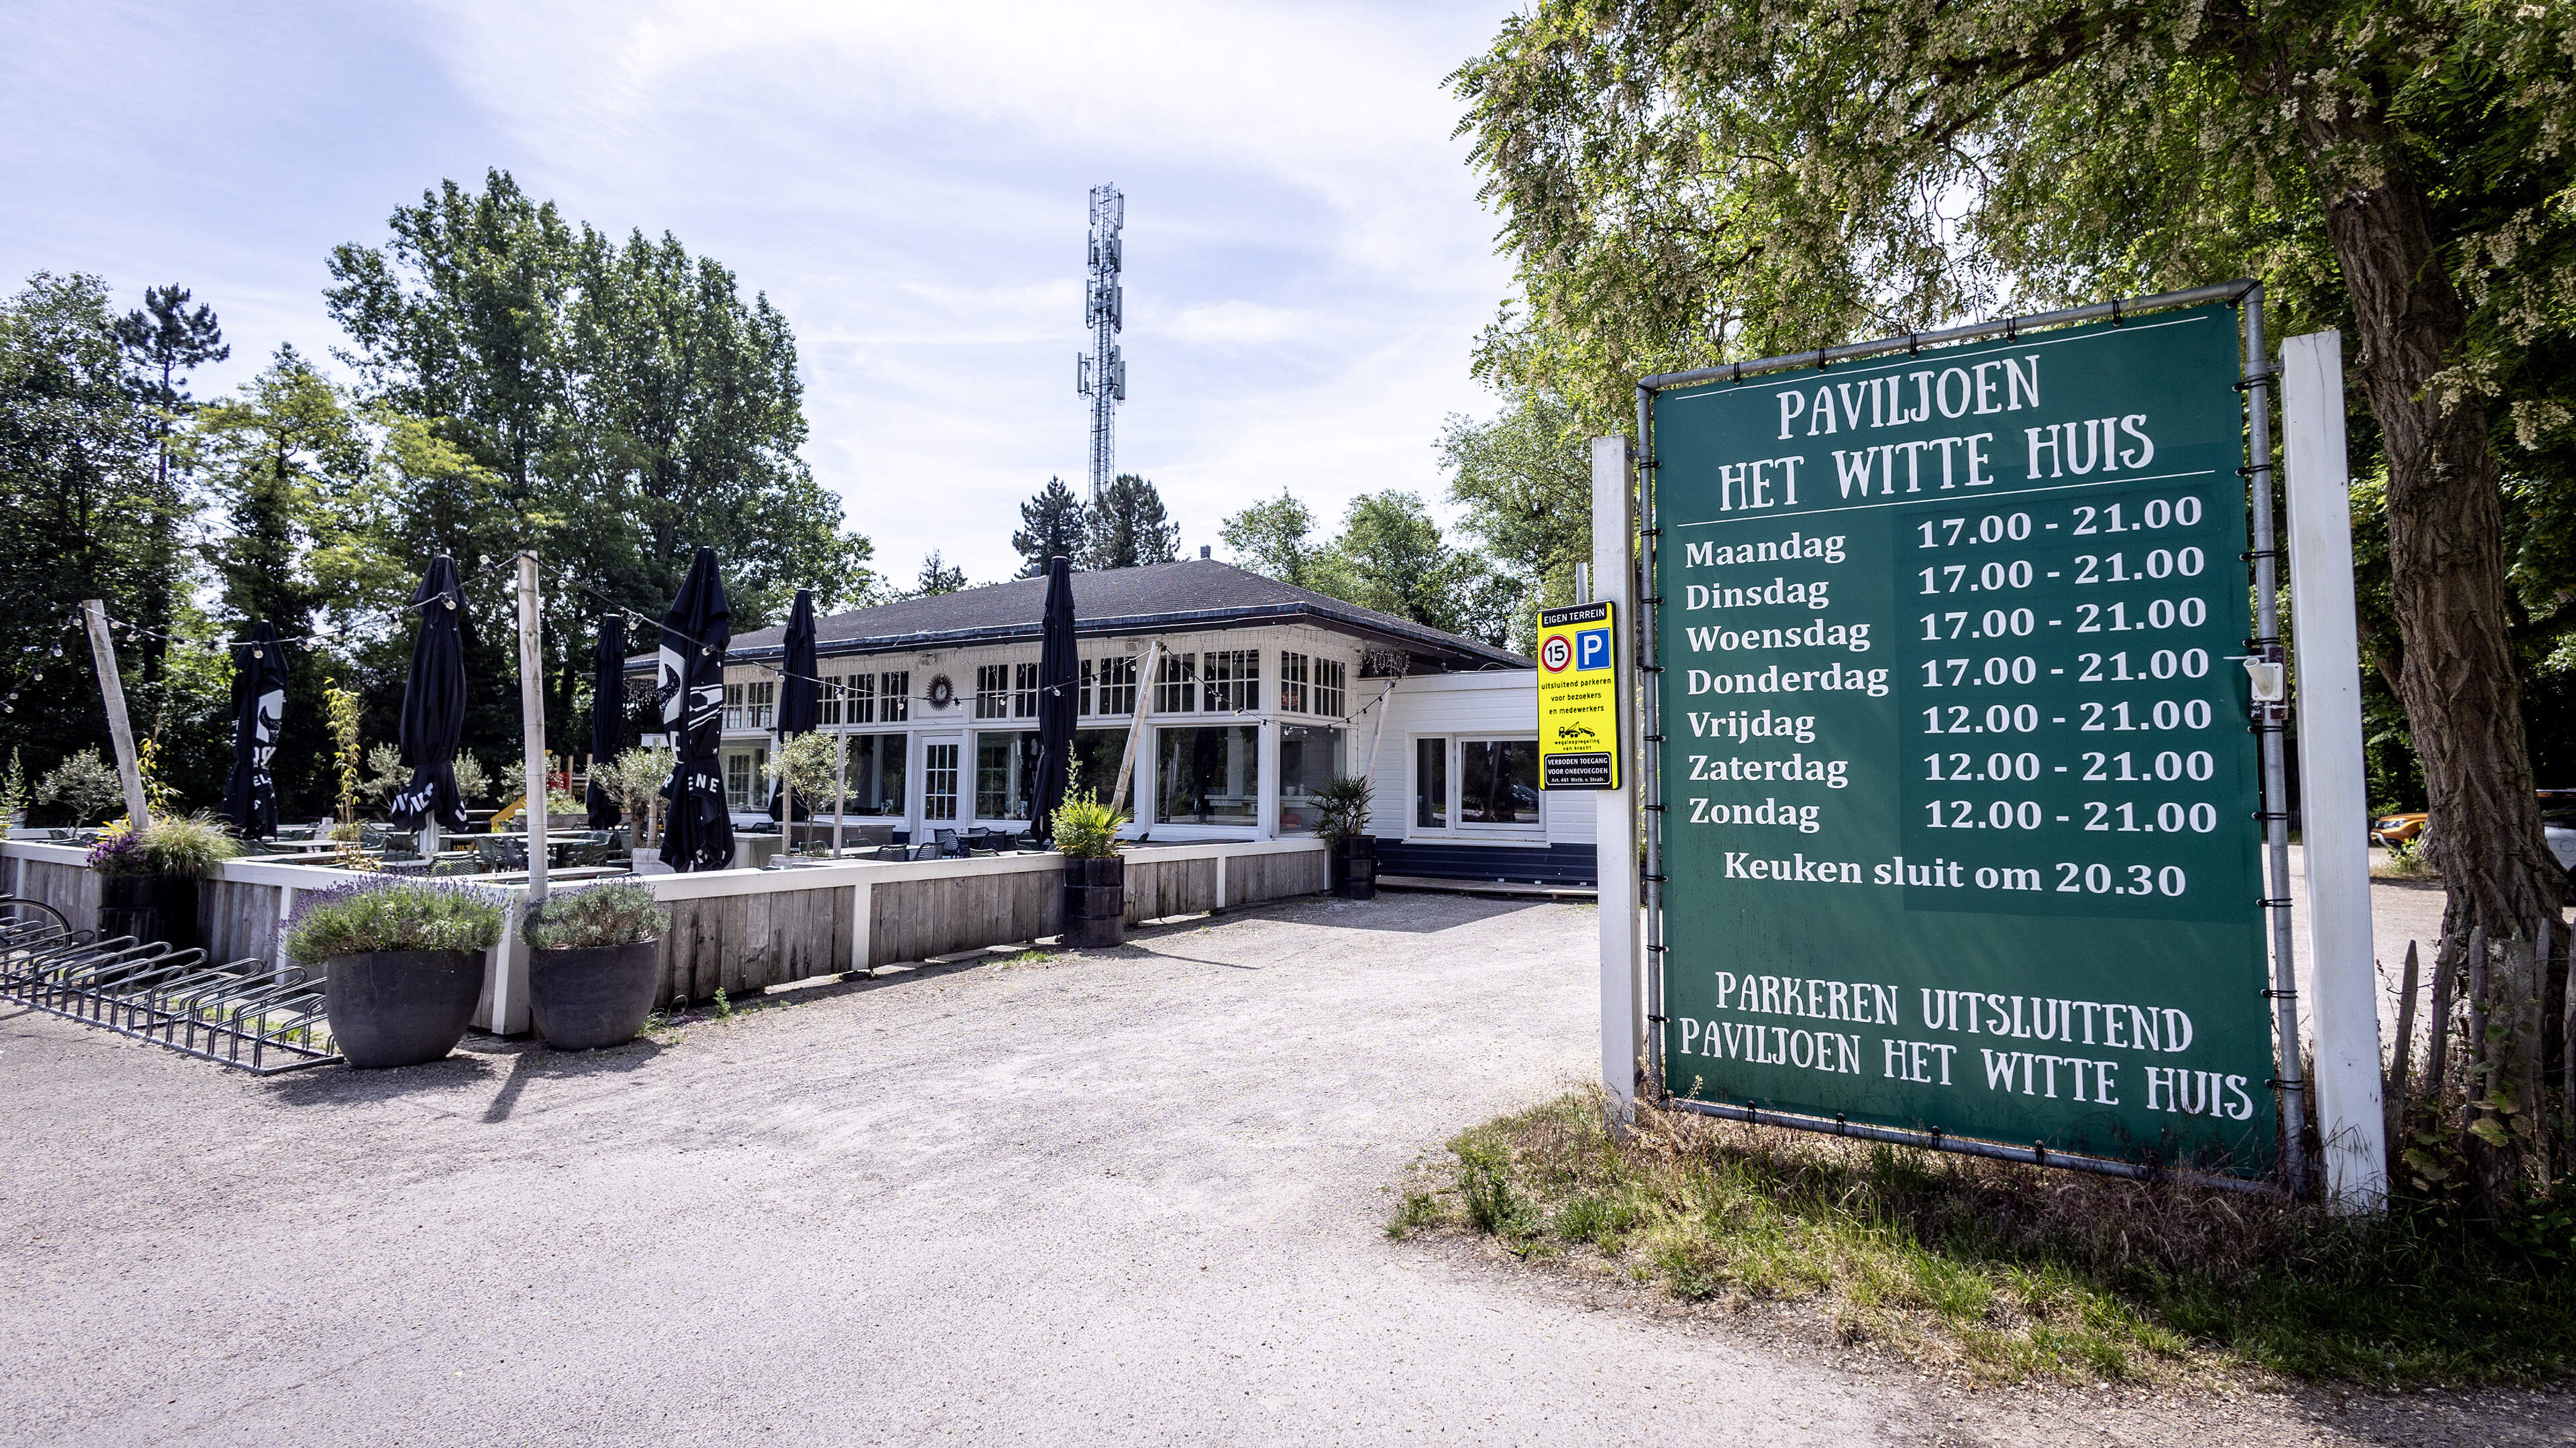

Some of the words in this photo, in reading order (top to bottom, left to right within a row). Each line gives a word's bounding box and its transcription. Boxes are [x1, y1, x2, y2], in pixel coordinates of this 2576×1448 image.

[1776, 355, 2039, 439] PAVILJOEN
[1719, 456, 1804, 511] HET
[1831, 433, 1993, 498] WITTE
[2025, 414, 2153, 479] HUIS
[1685, 532, 1845, 567] Maandag
[1918, 513, 2031, 548] 17.00
[2074, 497, 2201, 535] 21.00
[1686, 577, 1829, 610] Dinsdag
[1919, 561, 2033, 594] 17.00
[2075, 547, 2204, 583] 21.00
[1544, 614, 1567, 624] EIGEN
[1569, 608, 1605, 620] TERREIN
[1685, 619, 1870, 652] Woensdag
[1920, 608, 2034, 640] 17.00
[2076, 598, 2206, 632] 21.00
[1548, 645, 1565, 662] 15
[1584, 634, 1603, 665] P
[1542, 680, 1578, 689] uitsluitend
[1580, 678, 1611, 687] parkeren
[1687, 663, 1888, 697] Donderdag
[1921, 656, 2036, 687] 17.00
[2079, 649, 2208, 681] 21.00
[1559, 706, 1604, 714] medewerkers
[1567, 692, 1601, 700] bezoekers
[1687, 710, 1815, 744] Vrijdag
[1923, 704, 2037, 733] 12.00
[2080, 700, 2211, 730] 21.00
[1689, 753, 1848, 789] Zaterdag
[1925, 753, 2039, 781] 12.00
[2082, 751, 2213, 781] 21.00
[1690, 798, 1819, 833] Zondag
[1926, 801, 2041, 829] 12.00
[2084, 802, 2216, 832] 21.00
[1725, 852, 1862, 883] Keuken
[1874, 856, 1964, 887] sluit
[1976, 868, 2042, 890] om
[2056, 863, 2185, 896] 20.30
[1715, 972, 1898, 1025] PARKEREN
[1921, 989, 2192, 1052] UITSLUITEND
[1679, 1018, 1860, 1074] PAVILJOEN
[1882, 1039, 1957, 1085] HET
[1980, 1049, 2118, 1105] WITTE
[2145, 1067, 2252, 1119] HUIS
